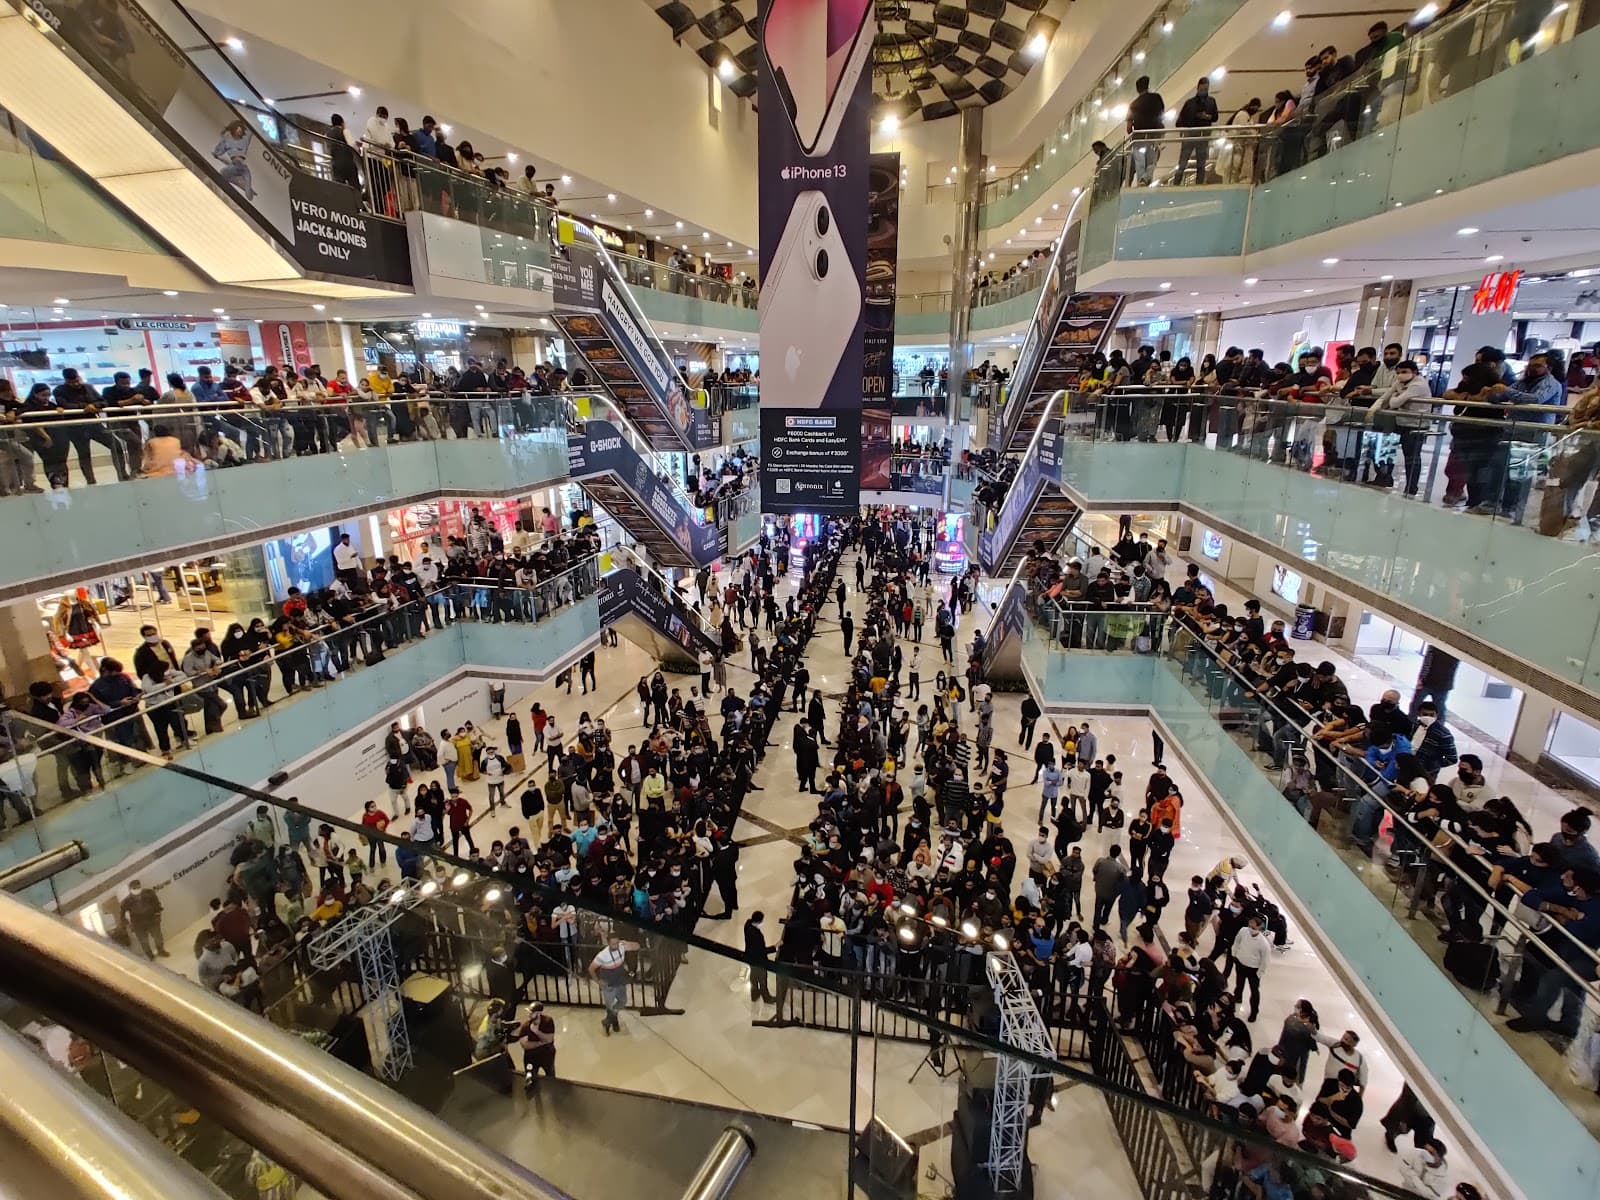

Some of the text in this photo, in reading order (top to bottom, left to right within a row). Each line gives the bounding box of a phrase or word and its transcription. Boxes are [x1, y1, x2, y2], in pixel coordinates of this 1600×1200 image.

[27, 0, 61, 30] OOR
[262, 150, 290, 181] ONLY
[791, 164, 847, 179] iPhone 13
[291, 199, 366, 232] VERO MODA
[296, 218, 367, 249] JACK&JONES
[318, 242, 350, 261] ONLY
[580, 278, 594, 292] MEE
[862, 376, 885, 393] OPEN
[590, 437, 621, 453] G-SHOCK
[795, 481, 823, 491] Aptronix
